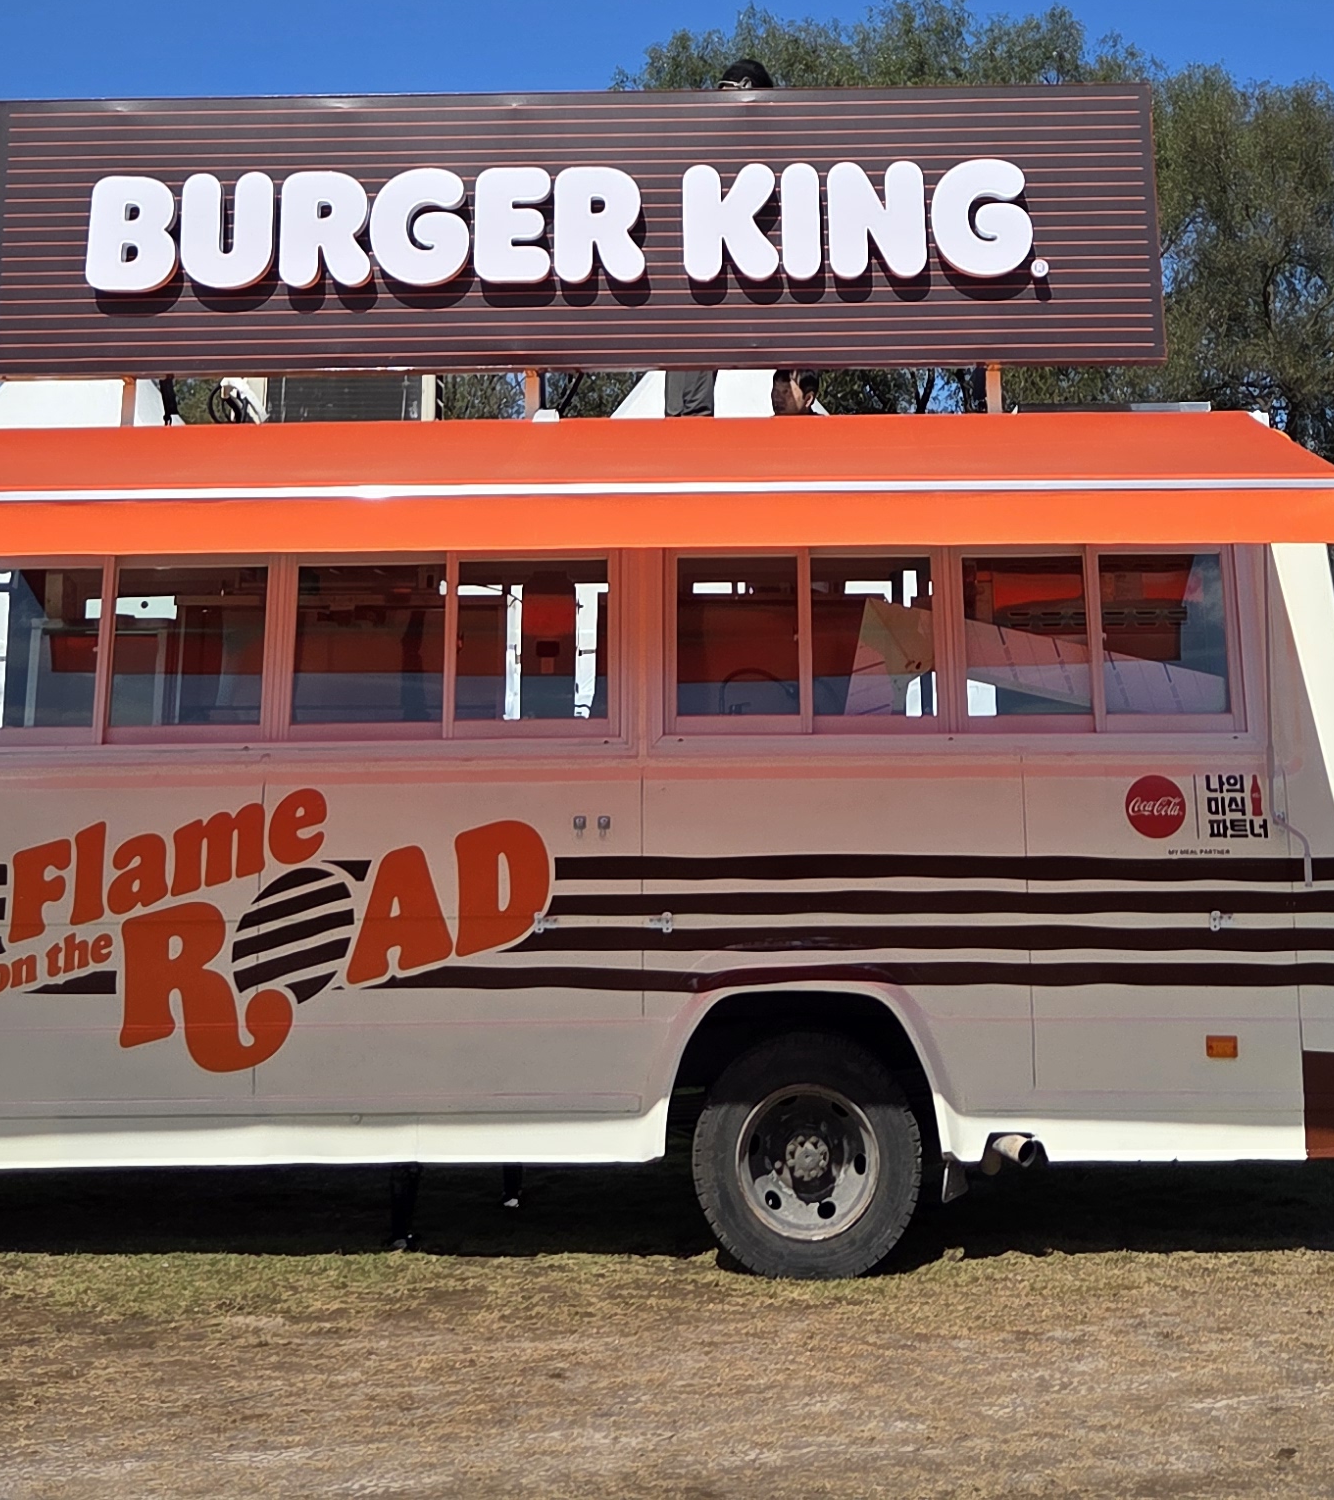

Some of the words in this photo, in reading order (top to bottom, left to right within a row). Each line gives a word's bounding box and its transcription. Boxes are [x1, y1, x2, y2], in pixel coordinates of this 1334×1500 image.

[84, 166, 646, 293] BURGER
[1205, 774, 1245, 794] 나의
[1207, 796, 1247, 816] 미식
[1208, 818, 1269, 839] 파트너
[7, 787, 328, 944] Flame
[46, 932, 113, 978] the
